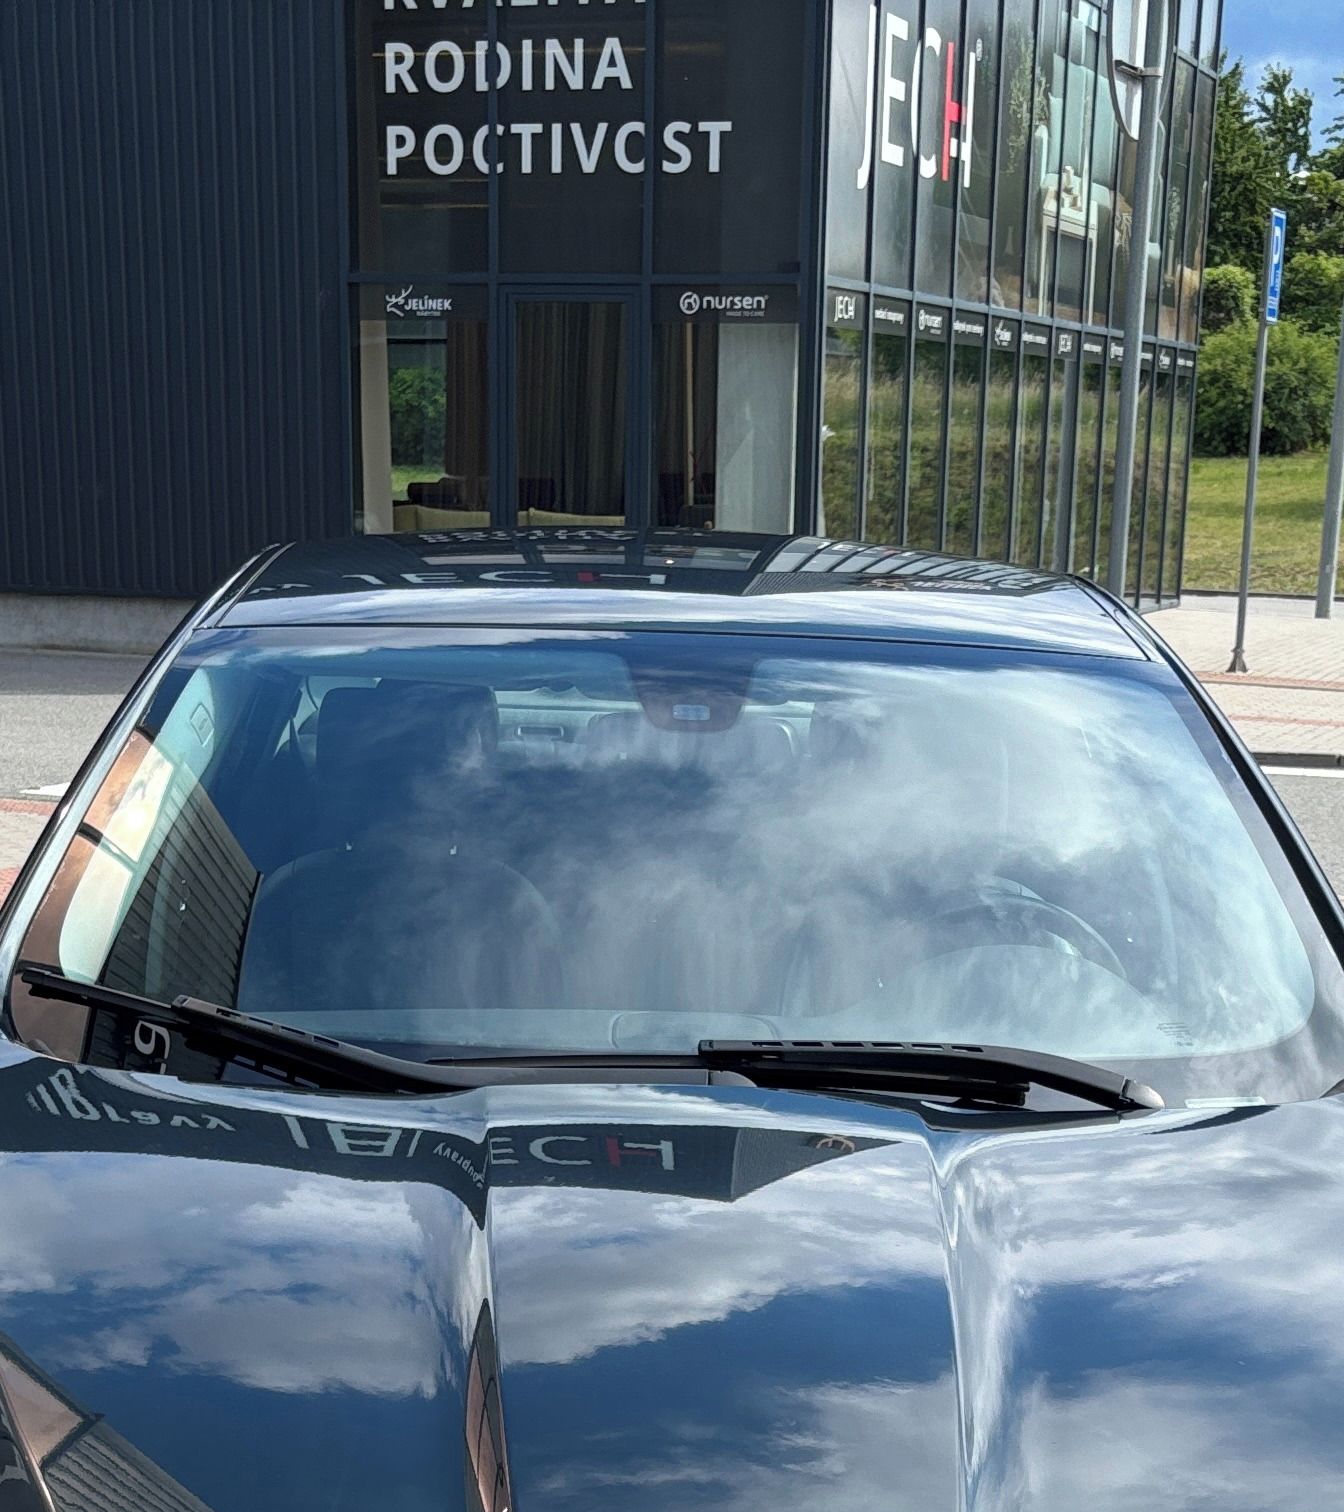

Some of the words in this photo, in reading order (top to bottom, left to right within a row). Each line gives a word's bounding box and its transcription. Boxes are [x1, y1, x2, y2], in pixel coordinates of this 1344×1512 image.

[384, 37, 633, 94] RODINA
[385, 121, 733, 175] POCTIVOST
[404, 295, 453, 310] JELÍNEK
[702, 295, 766, 310] nursen
